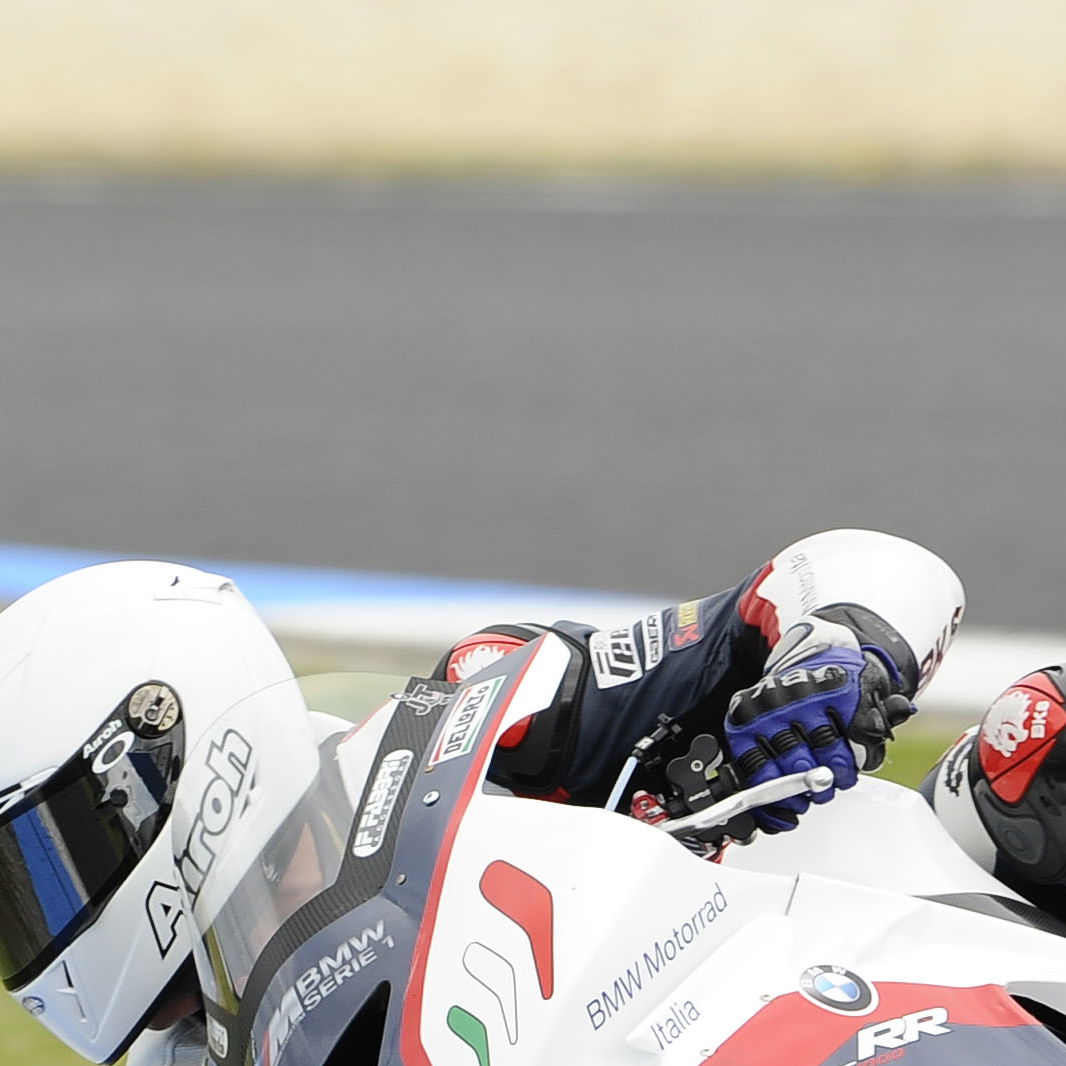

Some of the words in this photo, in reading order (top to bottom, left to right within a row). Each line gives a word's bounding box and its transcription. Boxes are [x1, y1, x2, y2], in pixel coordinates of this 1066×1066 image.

[83, 719, 123, 760] Airoh
[145, 728, 253, 961] Airoh
[295, 919, 385, 999] BMW
[303, 946, 378, 1011] SERIE
[382, 935, 395, 949] 1
[586, 961, 641, 1031] BMW
[643, 881, 728, 979] Motorrad
[650, 1000, 701, 1051] Italia
[857, 1007, 952, 1062] RR
